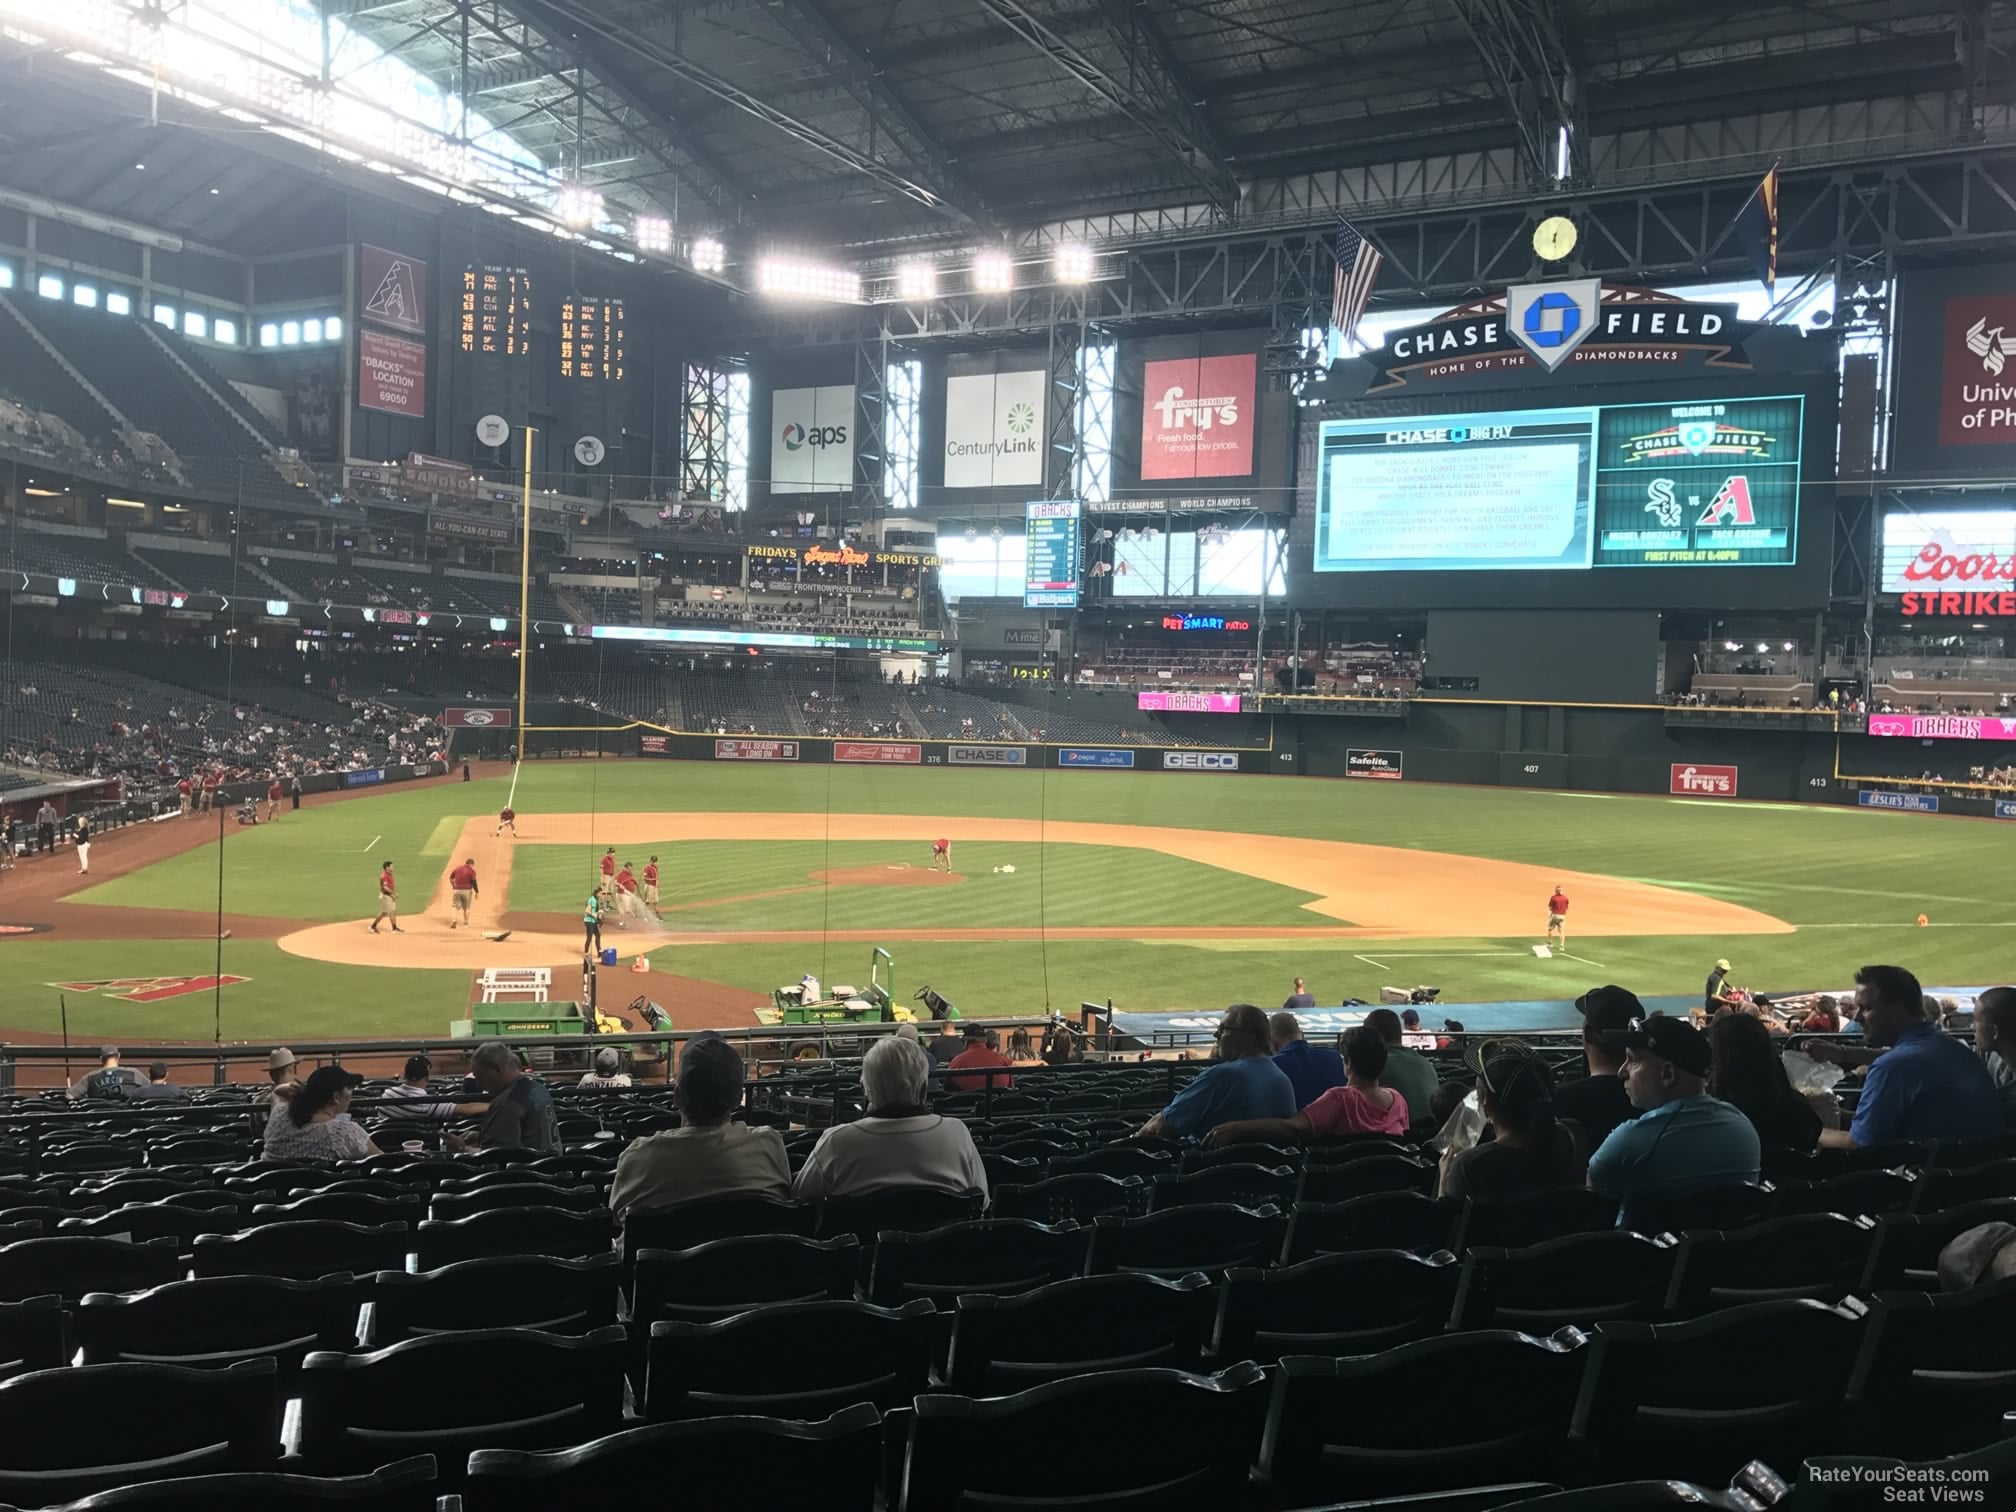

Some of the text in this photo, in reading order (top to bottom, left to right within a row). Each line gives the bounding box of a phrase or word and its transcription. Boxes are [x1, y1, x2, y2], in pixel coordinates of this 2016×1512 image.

[1393, 313, 1723, 358] CHASE FIELD
[1430, 351, 1678, 377] HOME OF THE DIAMONDBACKS
[373, 371, 414, 387] LOCATION
[380, 391, 407, 405] 69050
[1963, 382, 2016, 403] Univ
[1153, 386, 1238, 430] fry's
[1672, 405, 1725, 417] WELCOME TO
[1961, 408, 1986, 428] of
[808, 425, 847, 449] aps
[1158, 432, 1205, 443] Fresh food.
[1386, 426, 1513, 444] CHASE BIG FLY
[1635, 434, 1761, 450] CHASE FIELD
[947, 438, 1036, 462] CenturyLink
[1165, 441, 1239, 453] Famous low prices.
[1089, 500, 1165, 511] NL WEST CHAMPIONS
[1180, 498, 1251, 508] WORLD CHAMPIONS
[748, 546, 797, 558] FRIDAY'S
[876, 553, 919, 565] SPORTS
[1645, 551, 1669, 561] FIRST
[1670, 550, 1694, 560] PITCH
[1696, 551, 1707, 560] AT
[1904, 543, 2016, 581] Coors
[1901, 591, 2016, 616] STRIKE
[1163, 616, 1249, 630] PETSMART PATIO
[1006, 631, 1018, 642] M
[1912, 717, 1981, 739] DBACKS
[928, 756, 940, 764] 376
[956, 750, 1004, 761] CHASE
[1166, 753, 1235, 767] GEICO
[1349, 757, 1388, 766] Safelite
[1524, 765, 1539, 773] 407
[1678, 767, 1730, 792] fry's
[1810, 778, 1826, 787] 413
